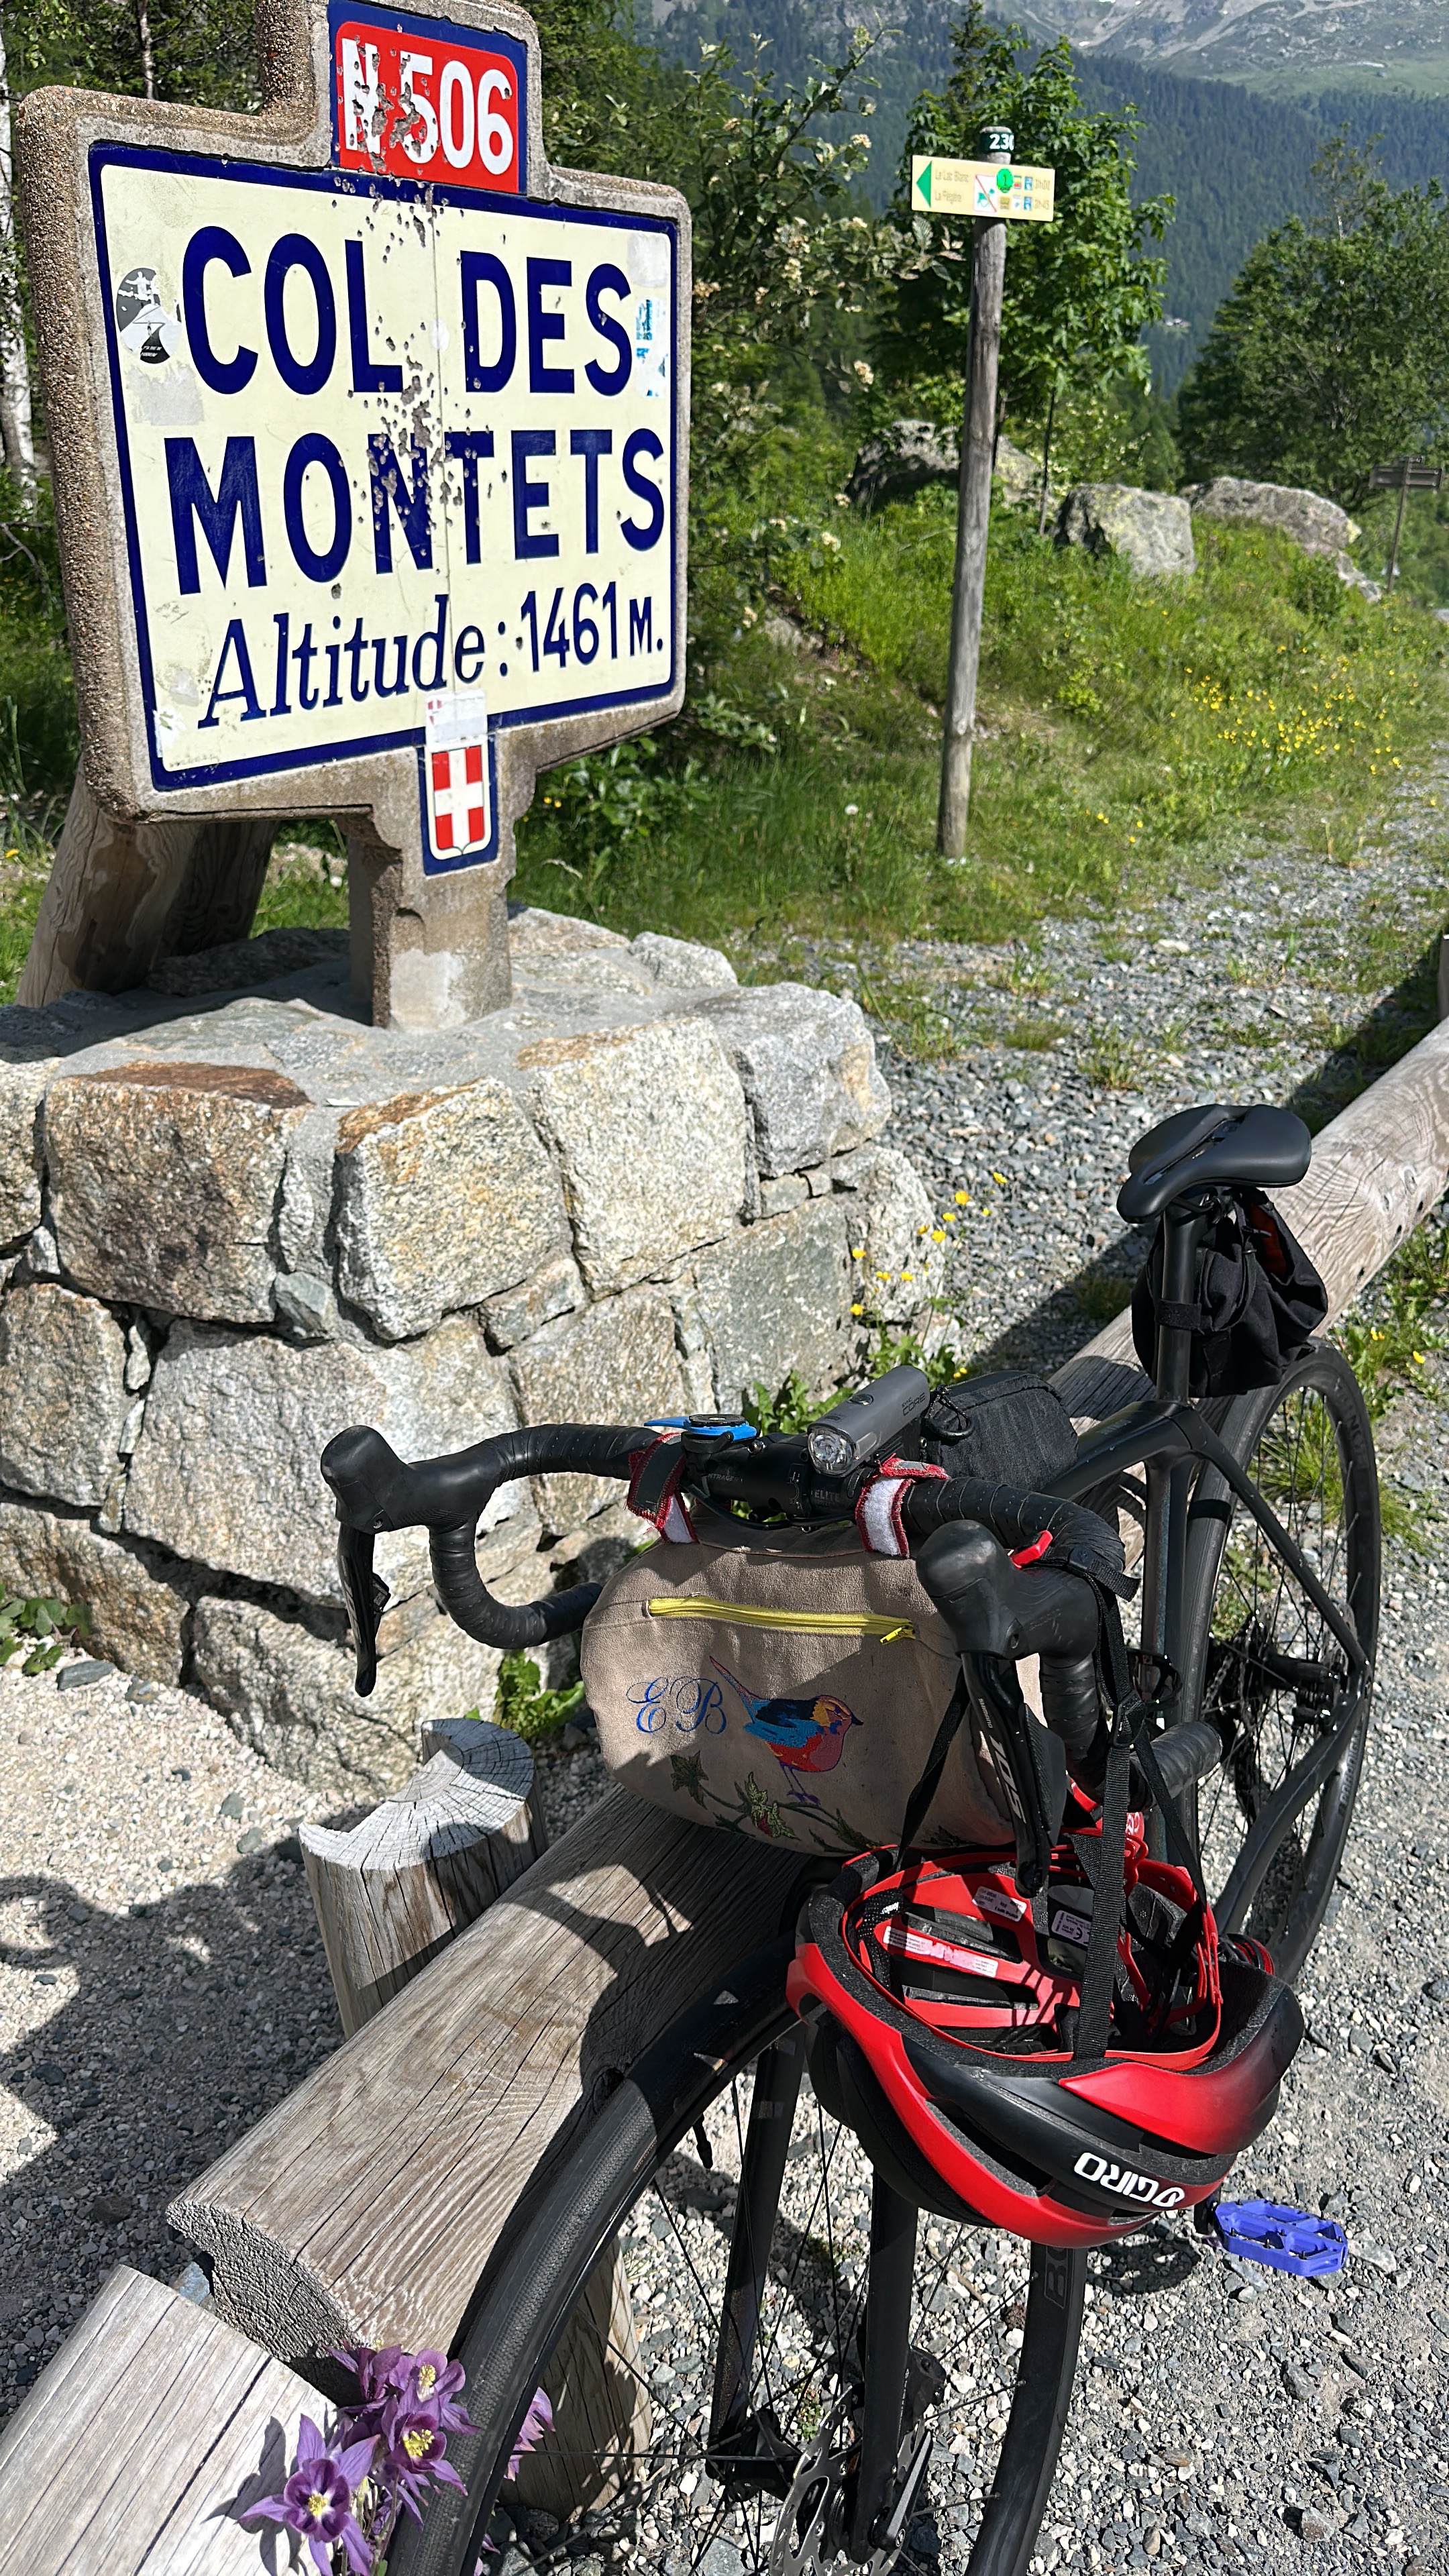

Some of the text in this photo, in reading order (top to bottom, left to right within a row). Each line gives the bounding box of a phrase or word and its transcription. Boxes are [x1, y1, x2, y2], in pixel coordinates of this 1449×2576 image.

[400, 50, 514, 175] 506
[182, 225, 632, 396] COL DES
[164, 428, 665, 596] MONTETS
[903, 1392, 926, 1415] CORE
[978, 1698, 994, 1729] SHIMANO
[1074, 2152, 1160, 2202] GIRO
